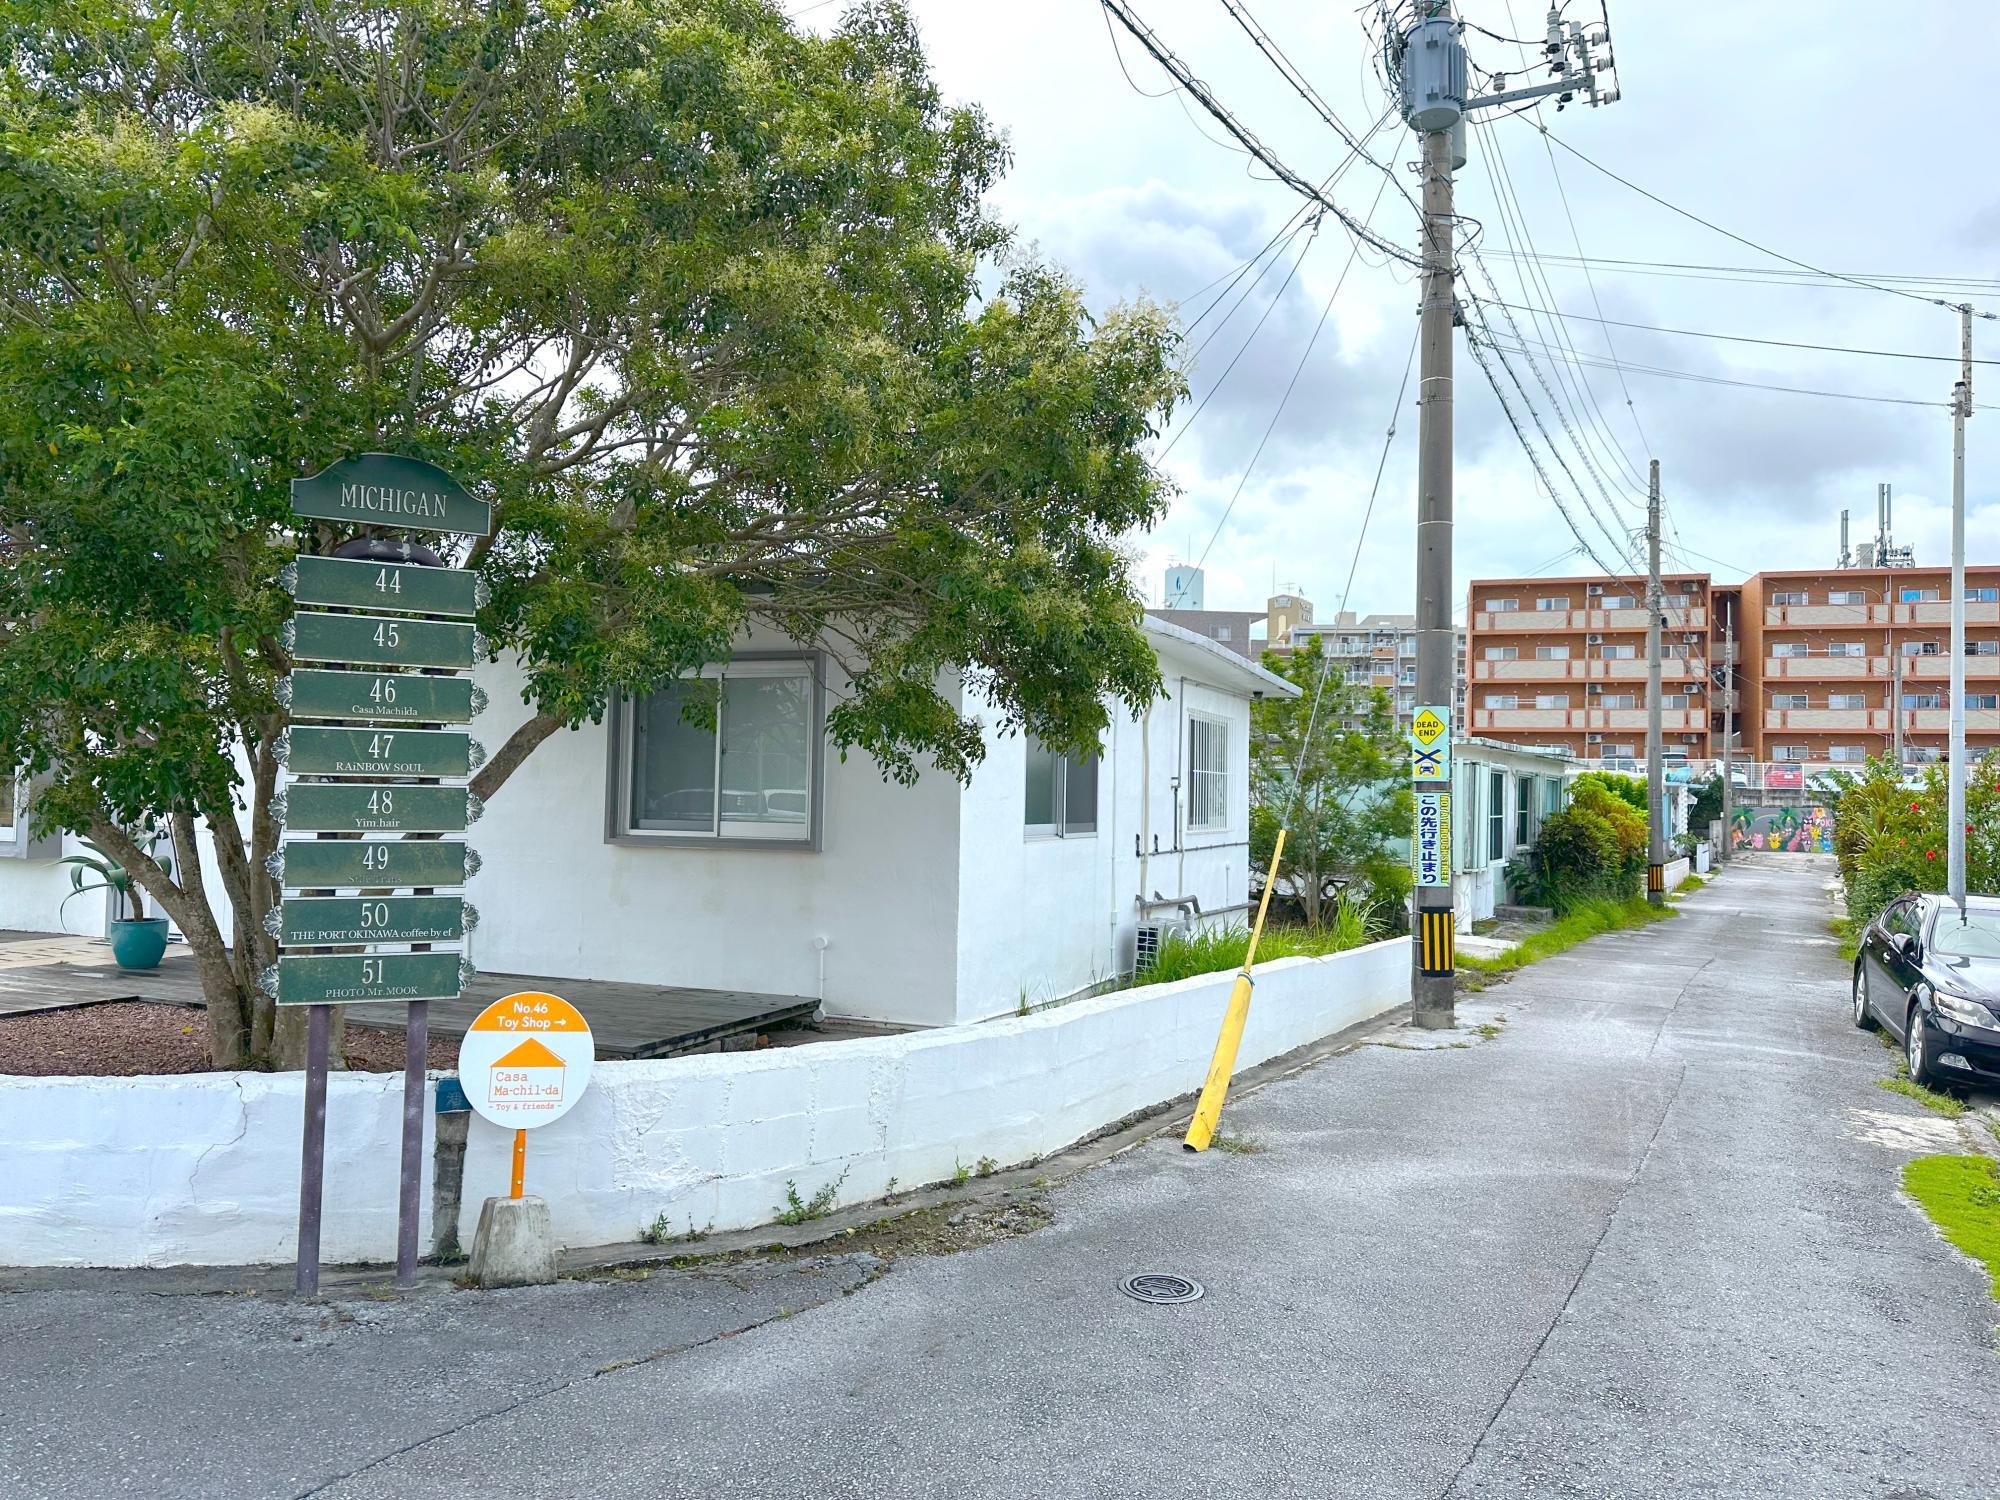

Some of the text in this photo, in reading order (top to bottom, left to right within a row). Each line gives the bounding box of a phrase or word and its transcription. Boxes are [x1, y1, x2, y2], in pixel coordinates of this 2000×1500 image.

[340, 483, 447, 517] MICHIGAN
[375, 568, 401, 593] 44
[373, 622, 399, 647] 45
[369, 678, 396, 703] 46
[352, 705, 418, 716] Casa Machilda
[368, 734, 394, 759] 47
[393, 762, 424, 772] SOUL
[367, 790, 393, 815] 48
[1440, 795, 1449, 810] NOT
[355, 818, 401, 828] Yim.hair
[1420, 795, 1438, 884] この先行き止まり
[1440, 819, 1449, 855] THROUGH
[362, 845, 389, 870] 49
[1440, 856, 1449, 883] STREET
[360, 902, 389, 928] 50
[291, 931, 315, 940] THE
[318, 930, 347, 940] PORT
[348, 929, 399, 939] OKINAWA
[401, 928, 429, 938] coffee
[430, 928, 442, 939] by
[362, 959, 383, 985] 51
[325, 988, 365, 998] PHOTO
[513, 1002, 548, 1014] No.46
[497, 1016, 551, 1030] Toy Shop
[495, 1071, 528, 1082] Casa
[494, 1085, 559, 1096] Ma-chil-da
[496, 1103, 511, 1111] Toy
[522, 1102, 555, 1110] friends
